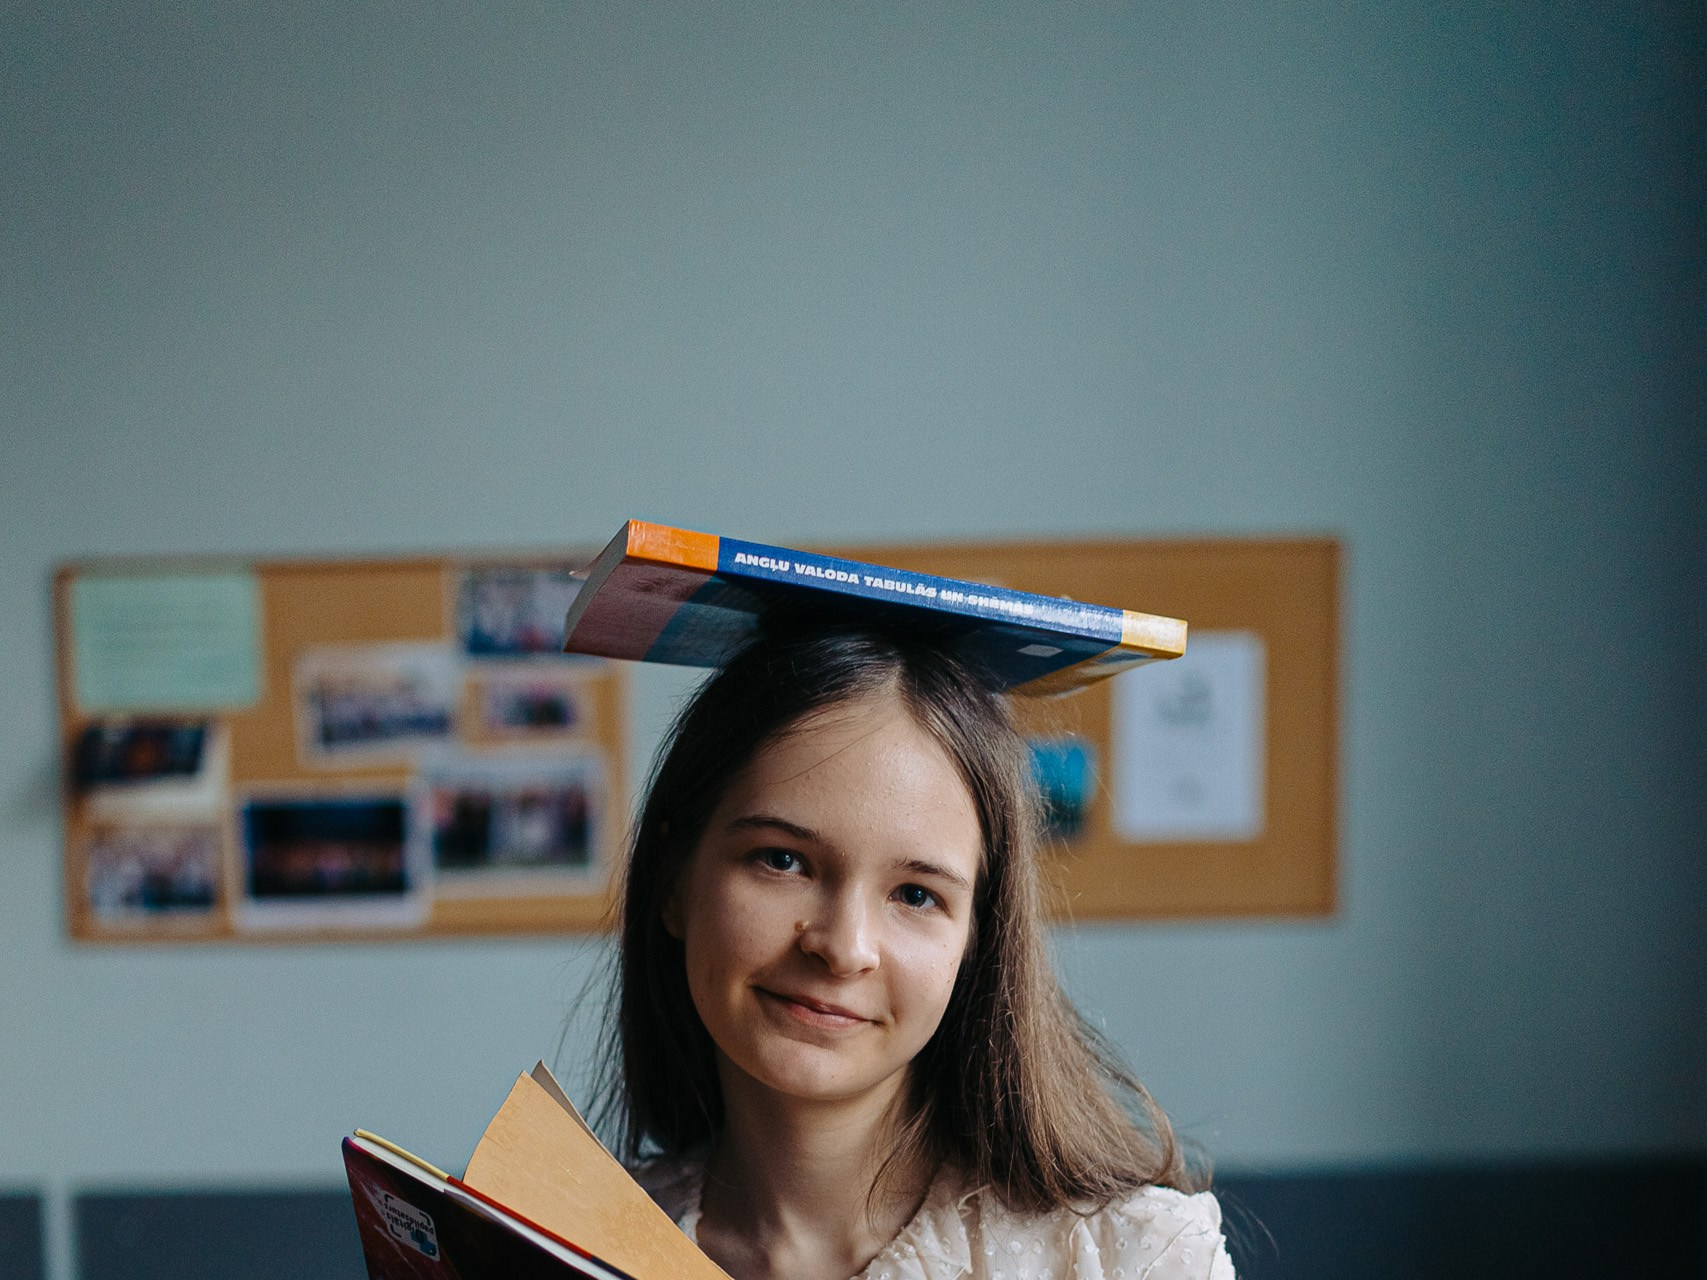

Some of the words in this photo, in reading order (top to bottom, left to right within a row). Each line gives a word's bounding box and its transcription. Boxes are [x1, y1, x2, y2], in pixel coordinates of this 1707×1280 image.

[735, 553, 789, 572] ANGĻU
[794, 563, 859, 584] VALODA
[864, 576, 937, 597] TABULĀS
[941, 590, 963, 602] UN
